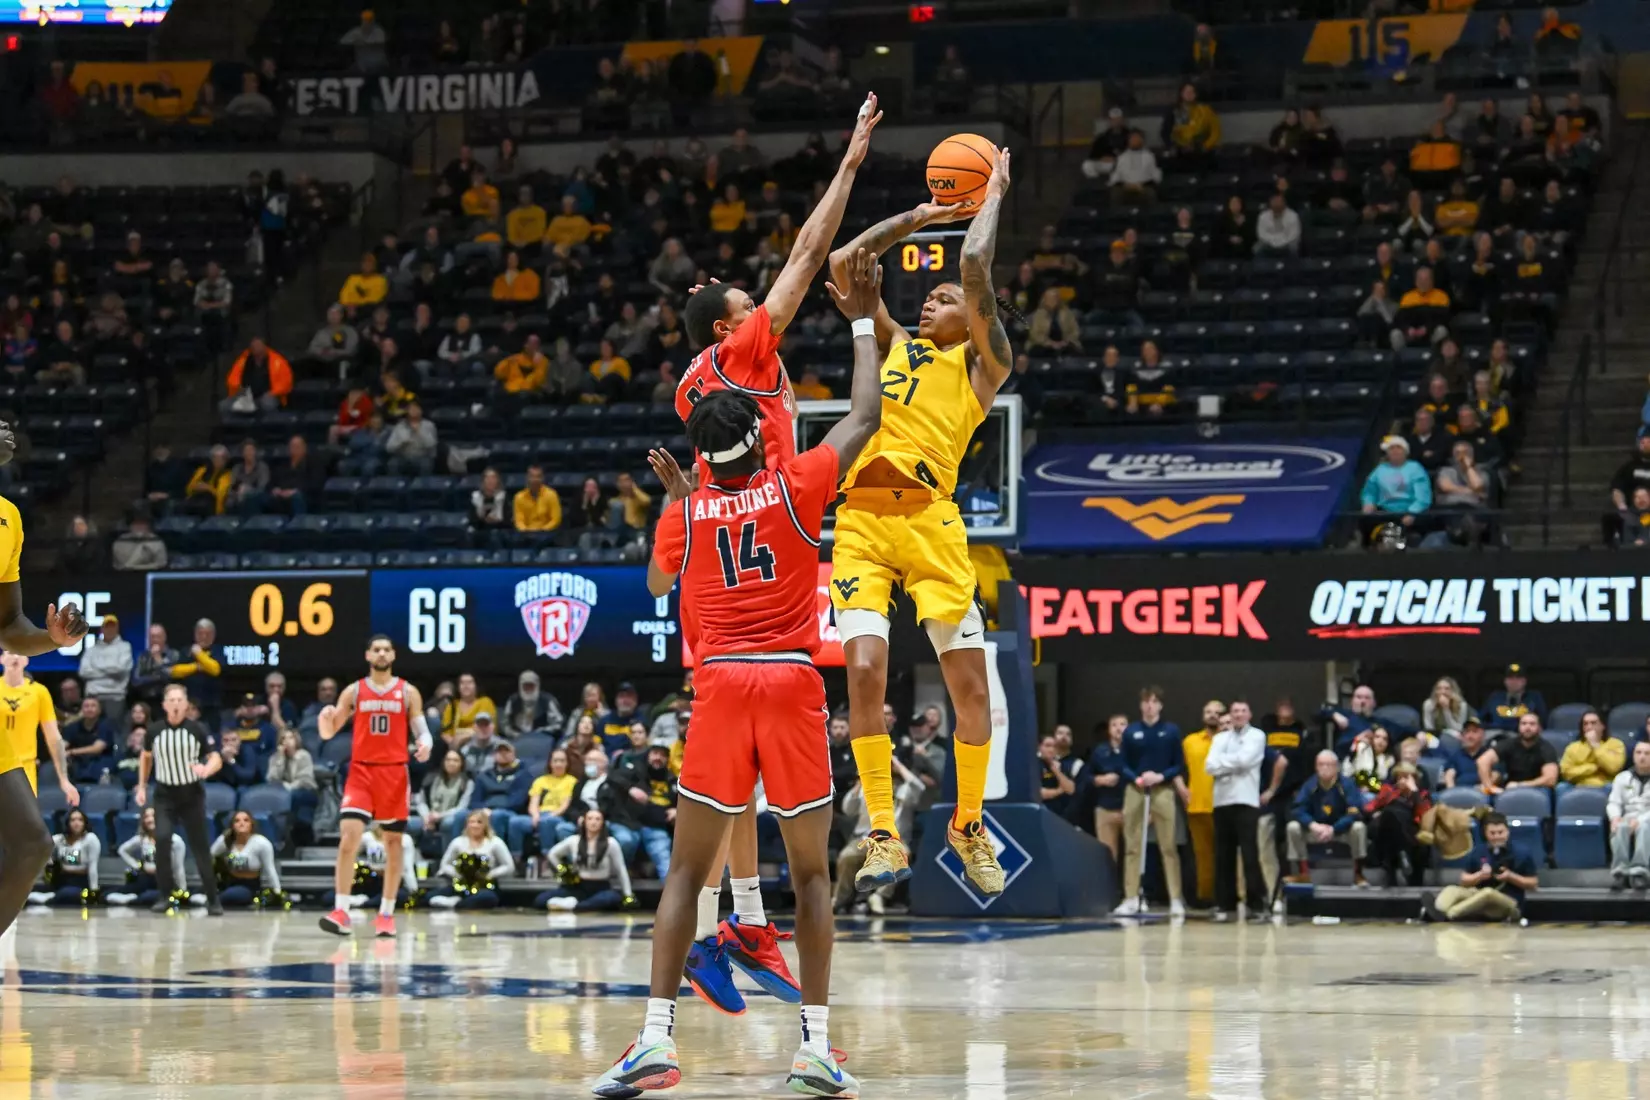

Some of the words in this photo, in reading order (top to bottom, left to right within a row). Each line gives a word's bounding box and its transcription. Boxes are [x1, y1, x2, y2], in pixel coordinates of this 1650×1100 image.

[287, 77, 365, 115] EST
[378, 70, 541, 113] VIRGINIA
[880, 370, 920, 406] 21
[1088, 454, 1195, 471] Little
[1106, 459, 1284, 481] General
[693, 482, 780, 521] ANTOINE
[716, 520, 777, 589] 14
[514, 571, 598, 608] RADFORD
[1309, 579, 1487, 626] OFFICIAL
[1492, 577, 1637, 623] TICKET
[248, 583, 333, 637] 0.6
[408, 587, 467, 653] 66
[632, 620, 677, 635] FOULS
[1018, 580, 1269, 641] EATGEEK
[267, 641, 280, 666] 2
[651, 634, 666, 662] 9
[369, 713, 390, 735] 10
